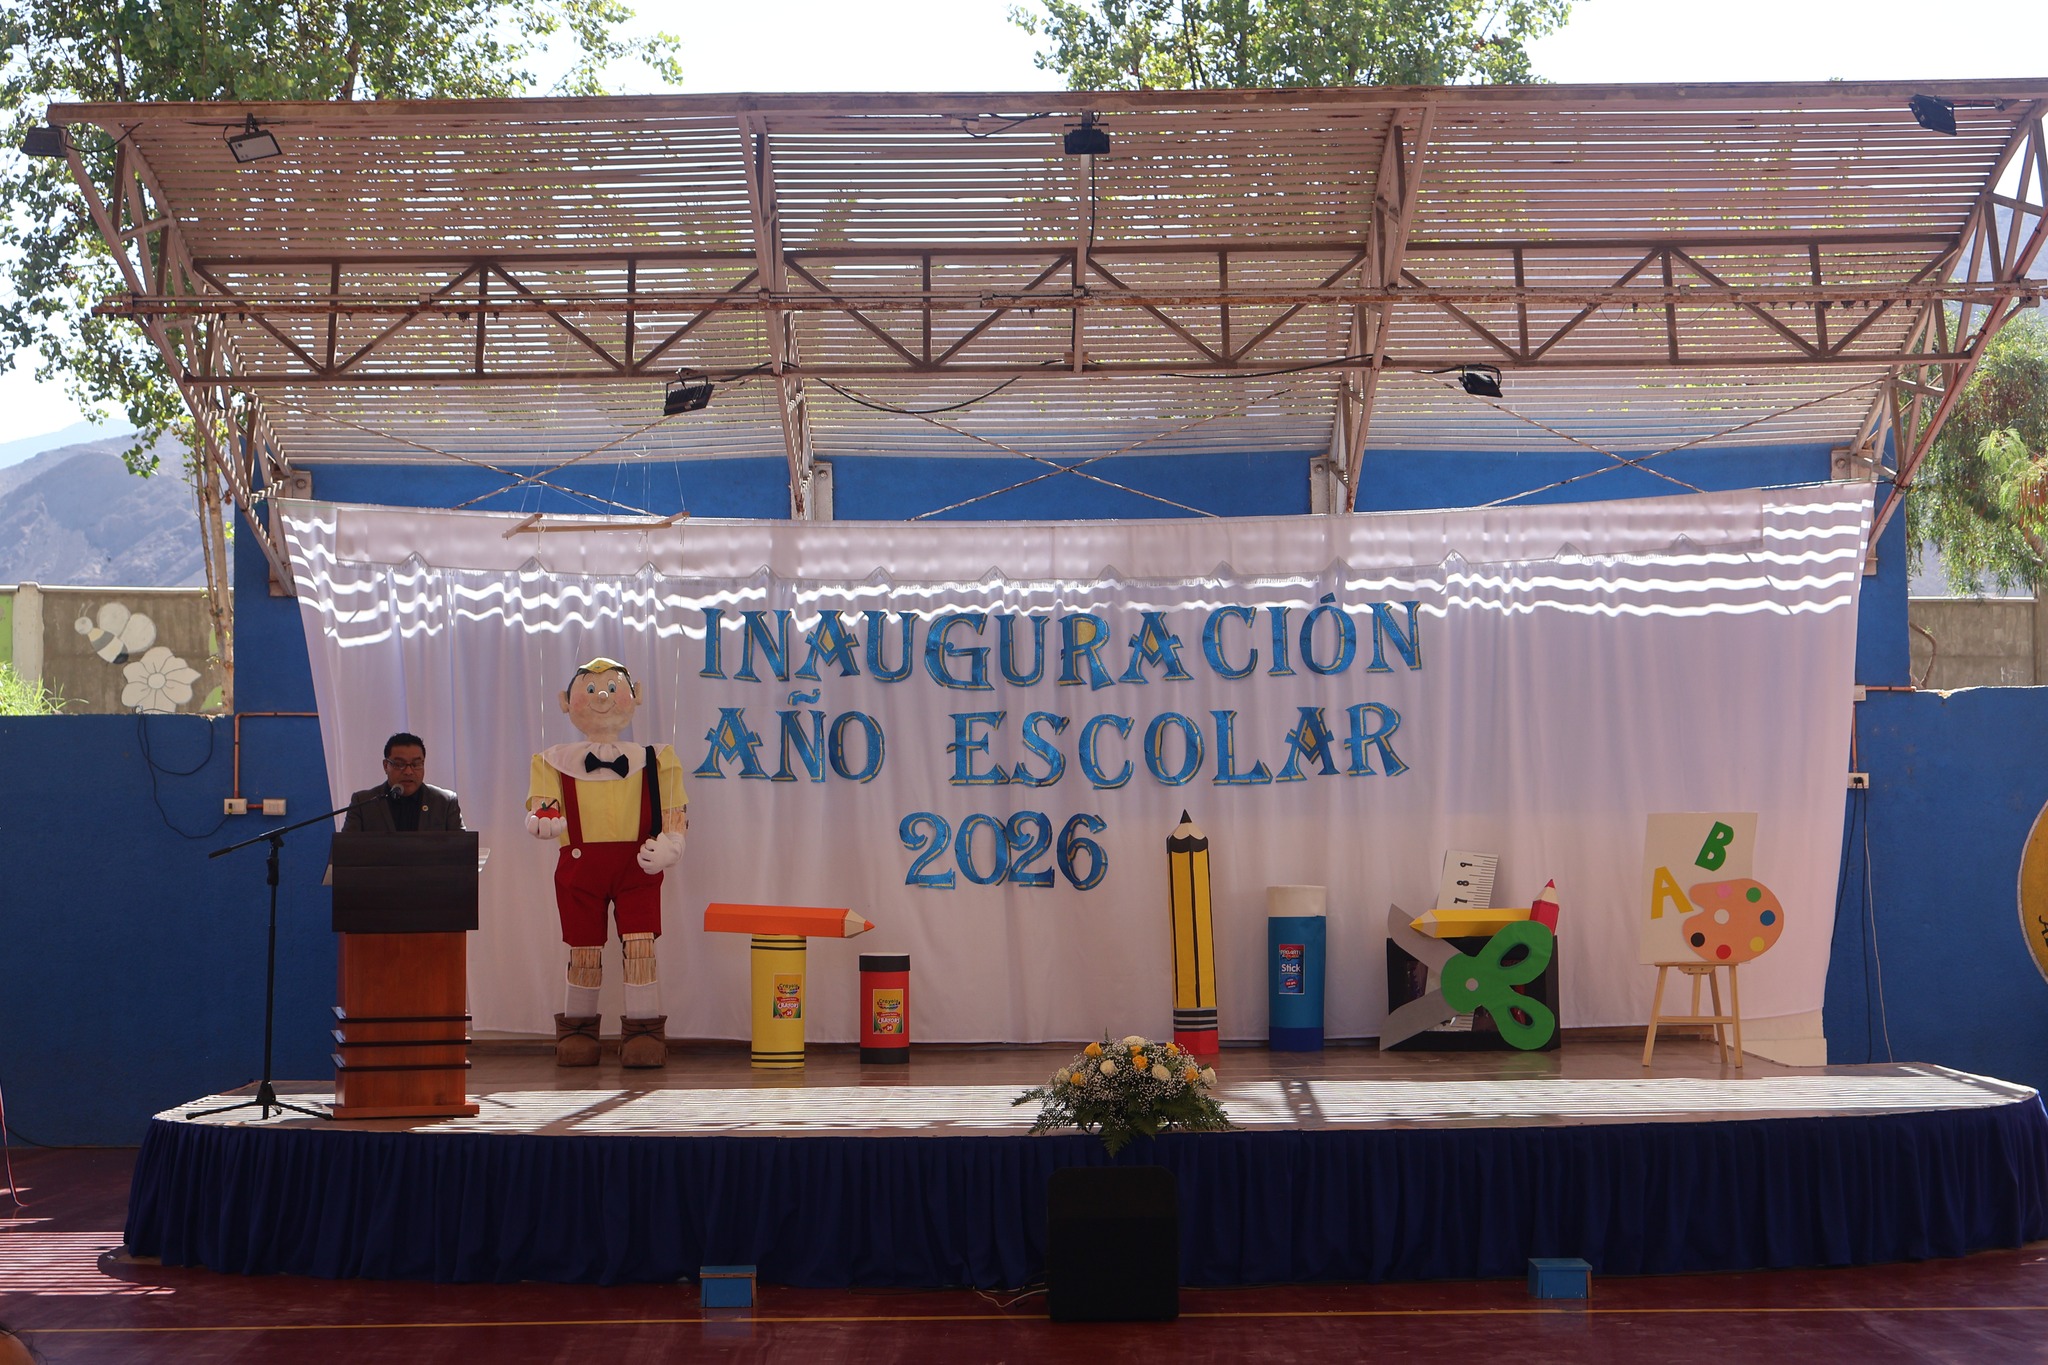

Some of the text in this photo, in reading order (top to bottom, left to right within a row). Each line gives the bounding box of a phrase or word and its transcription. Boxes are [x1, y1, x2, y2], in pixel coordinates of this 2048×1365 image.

[700, 592, 1423, 691] INAUGURACIÓN
[692, 688, 1409, 790] AÑO ESCOLAR
[900, 811, 1109, 890] 2026
[1694, 821, 1734, 871] B
[1650, 866, 1694, 919] A
[1281, 963, 1301, 972] Stick
